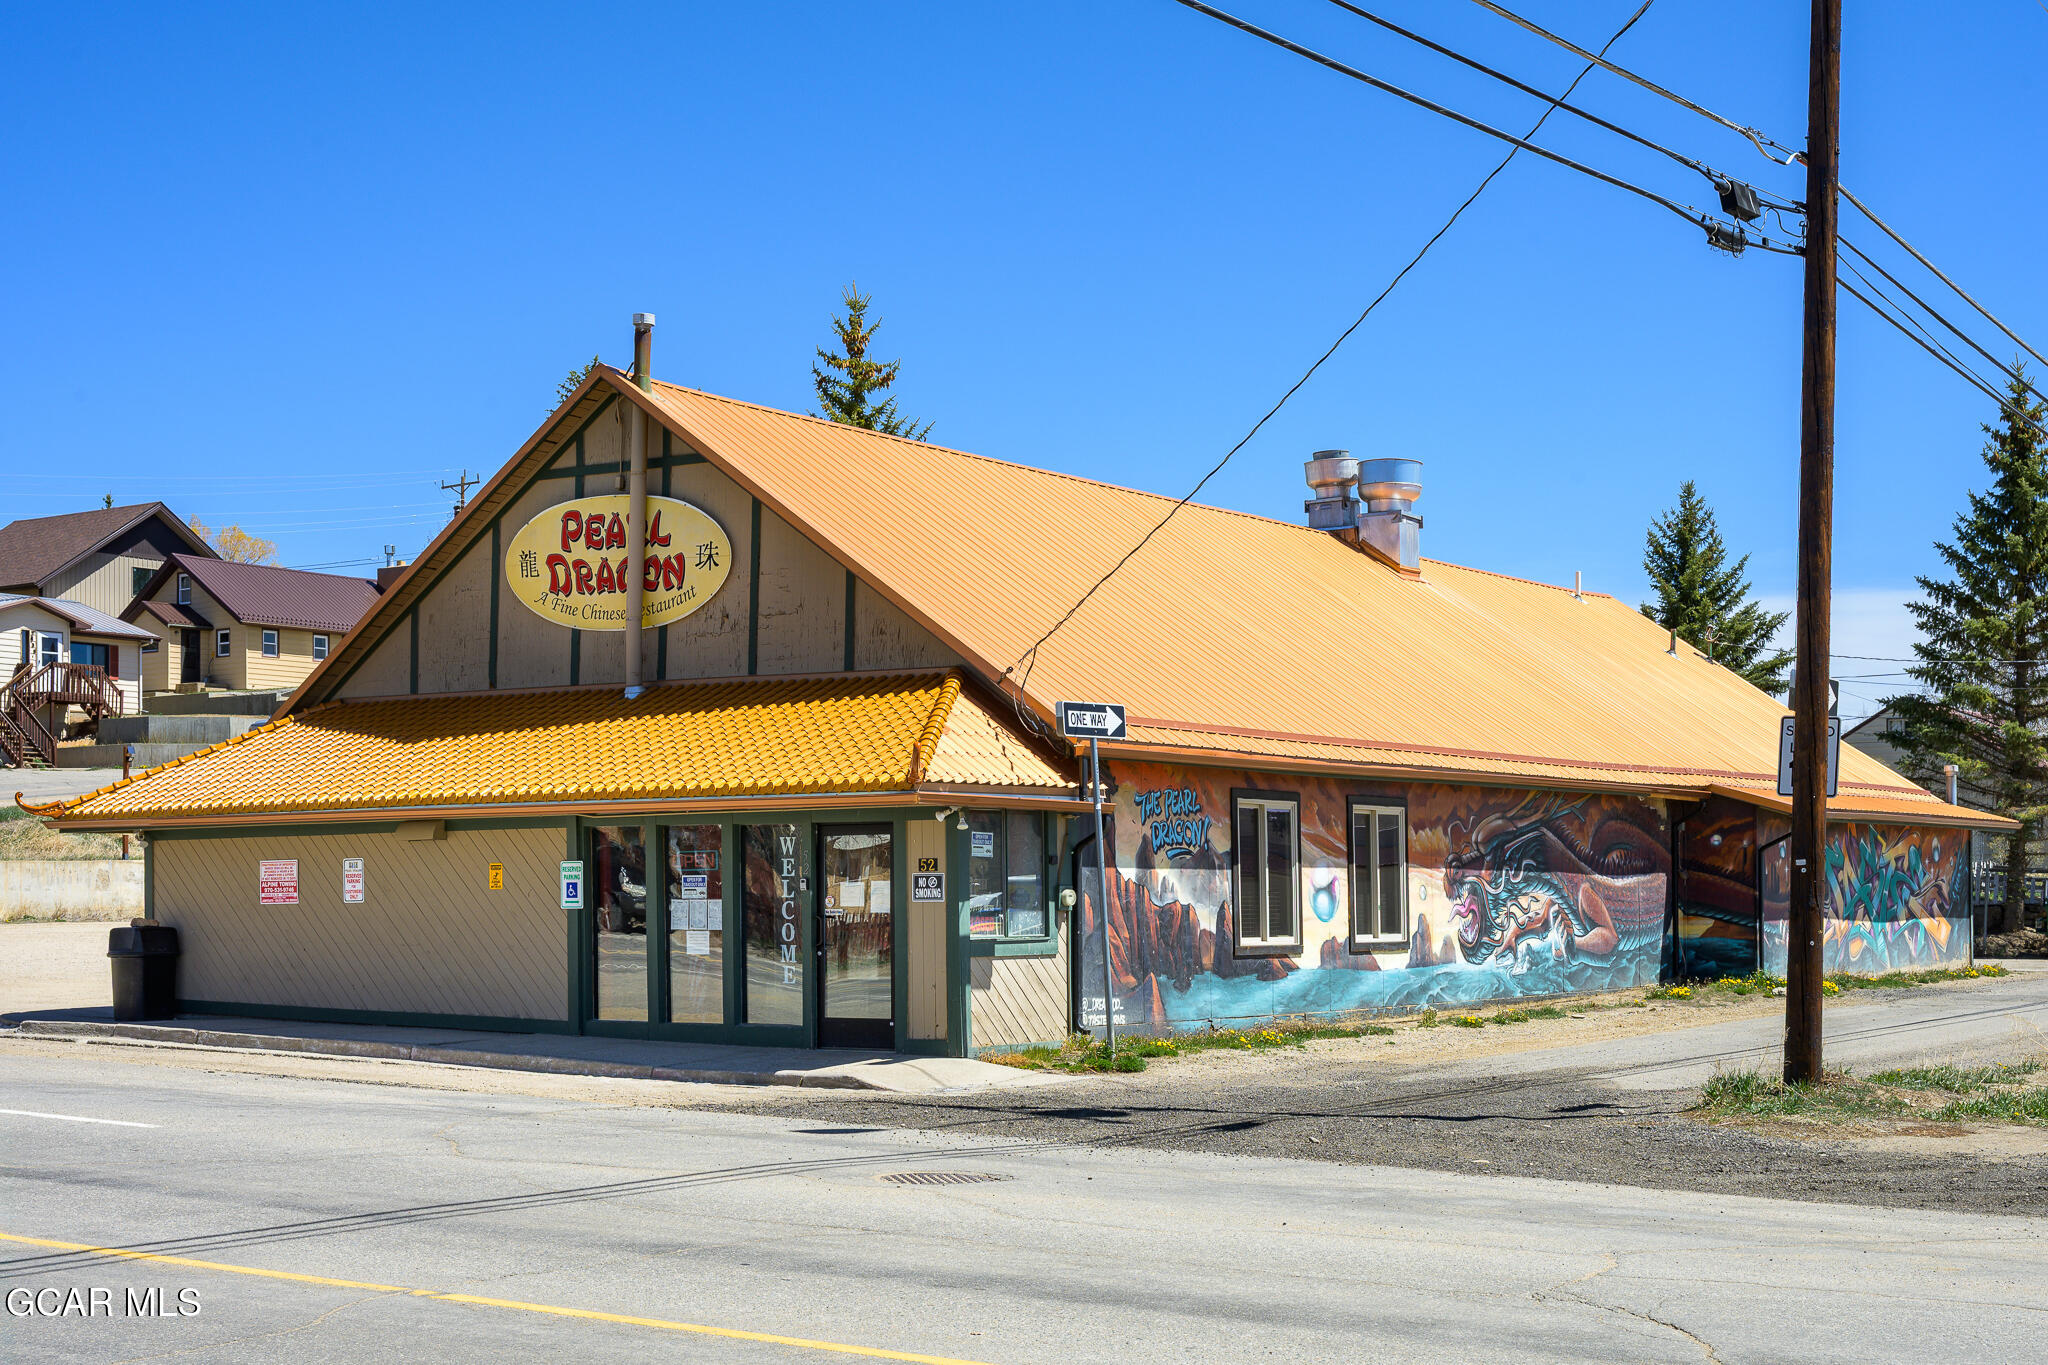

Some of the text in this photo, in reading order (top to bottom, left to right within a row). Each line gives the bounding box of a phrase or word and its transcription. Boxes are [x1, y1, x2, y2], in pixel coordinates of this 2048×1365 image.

[560, 509, 671, 552] PEAL
[519, 550, 539, 578] 龍
[695, 541, 719, 572] 珠
[534, 585, 697, 620] A Fine Chinese estaurant
[1071, 712, 1107, 727] ONE WAY
[1134, 787, 1202, 826] THE PEARL
[1150, 814, 1211, 855] DRAGON!
[672, 853, 715, 868] OPEN
[920, 858, 936, 871] 52
[915, 887, 942, 898] SMOKING
[918, 877, 927, 888] NO
[779, 836, 798, 984] WELCOME
